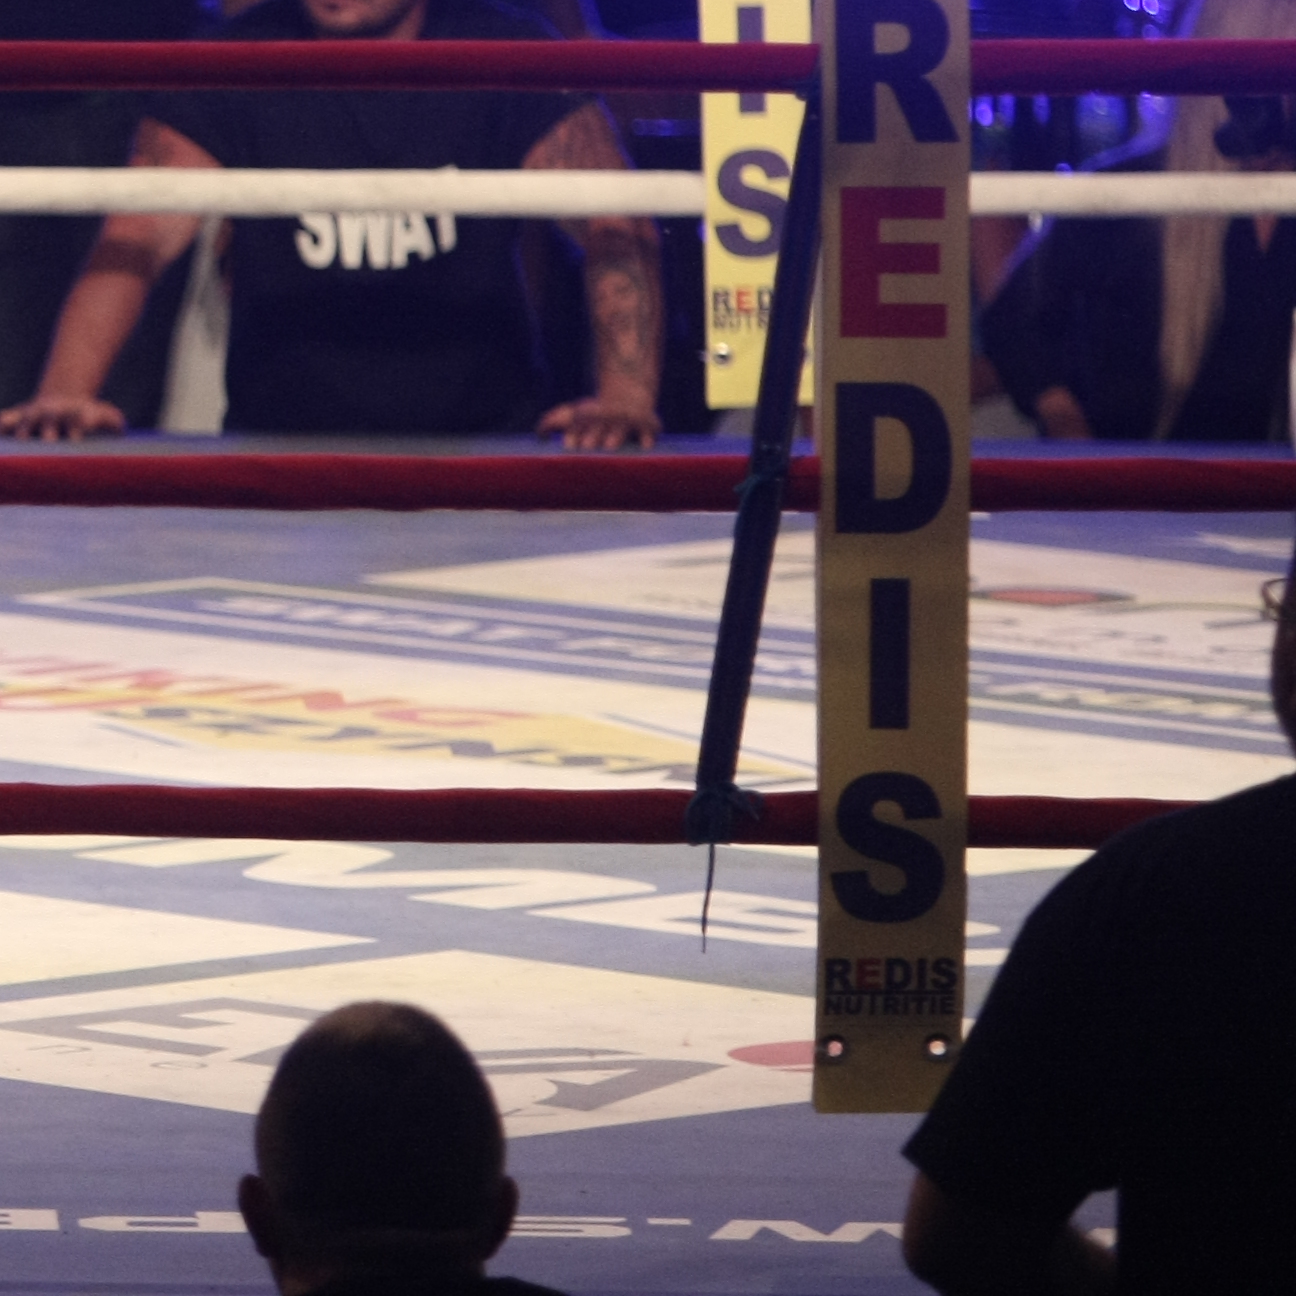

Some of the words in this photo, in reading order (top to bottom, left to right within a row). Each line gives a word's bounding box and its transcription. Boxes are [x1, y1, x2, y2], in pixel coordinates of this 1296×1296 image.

[712, 287, 774, 313] RED
[824, 958, 958, 991] REDIS
[824, 994, 957, 1016] NUTRITIE
